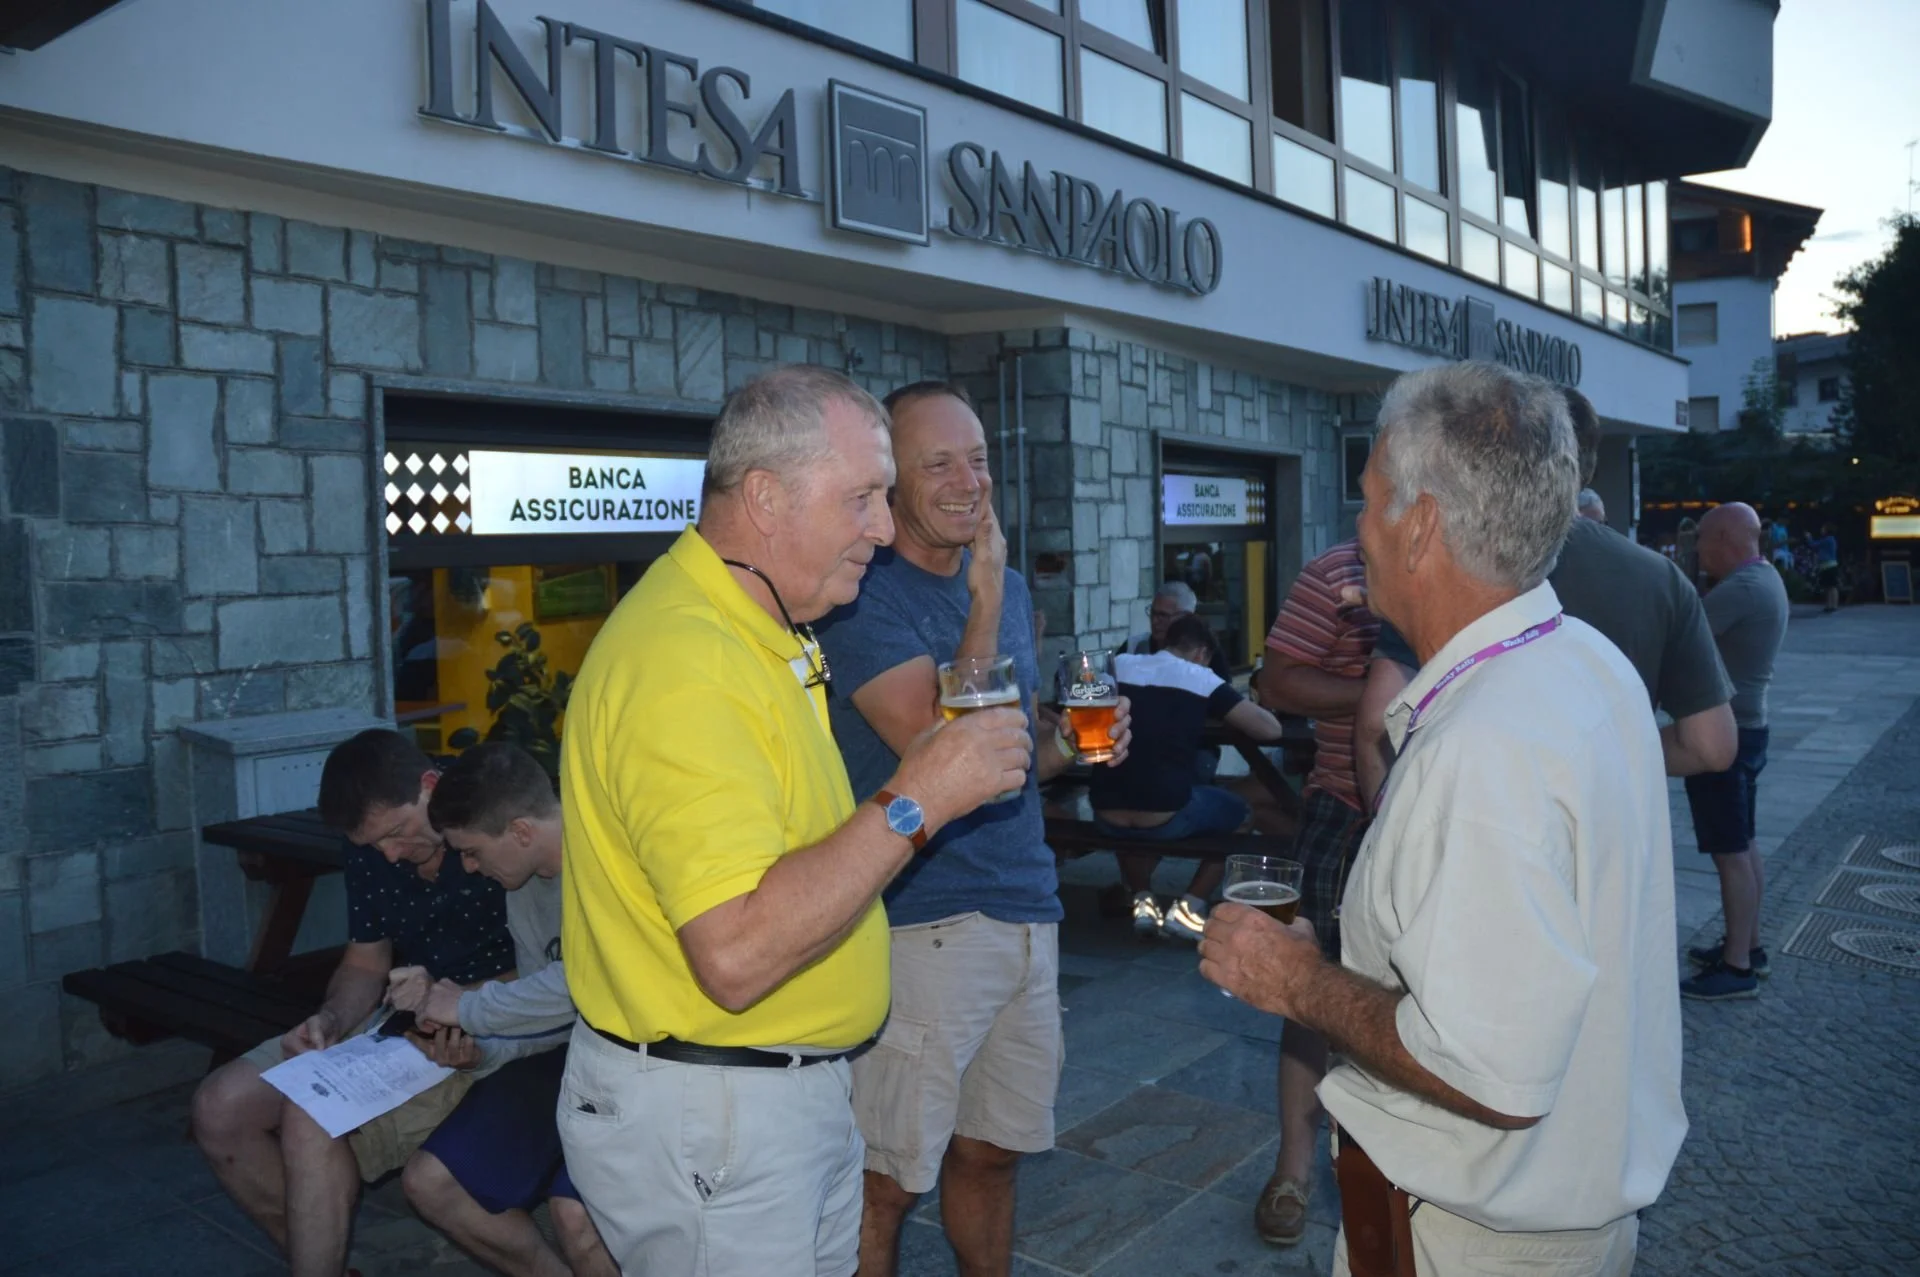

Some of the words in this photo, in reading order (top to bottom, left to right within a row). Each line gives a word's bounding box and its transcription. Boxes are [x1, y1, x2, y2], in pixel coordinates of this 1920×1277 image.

[416, 0, 809, 198] INTESA
[946, 140, 1224, 296] SANPAOLO
[1366, 276, 1467, 362] INTESA
[1495, 317, 1582, 387] SANPAOLO
[568, 466, 646, 490] BANCA
[1194, 483, 1220, 498] BANCA
[509, 498, 696, 522] ASSICURAZIONE
[1071, 681, 1110, 699] Carlsberg
